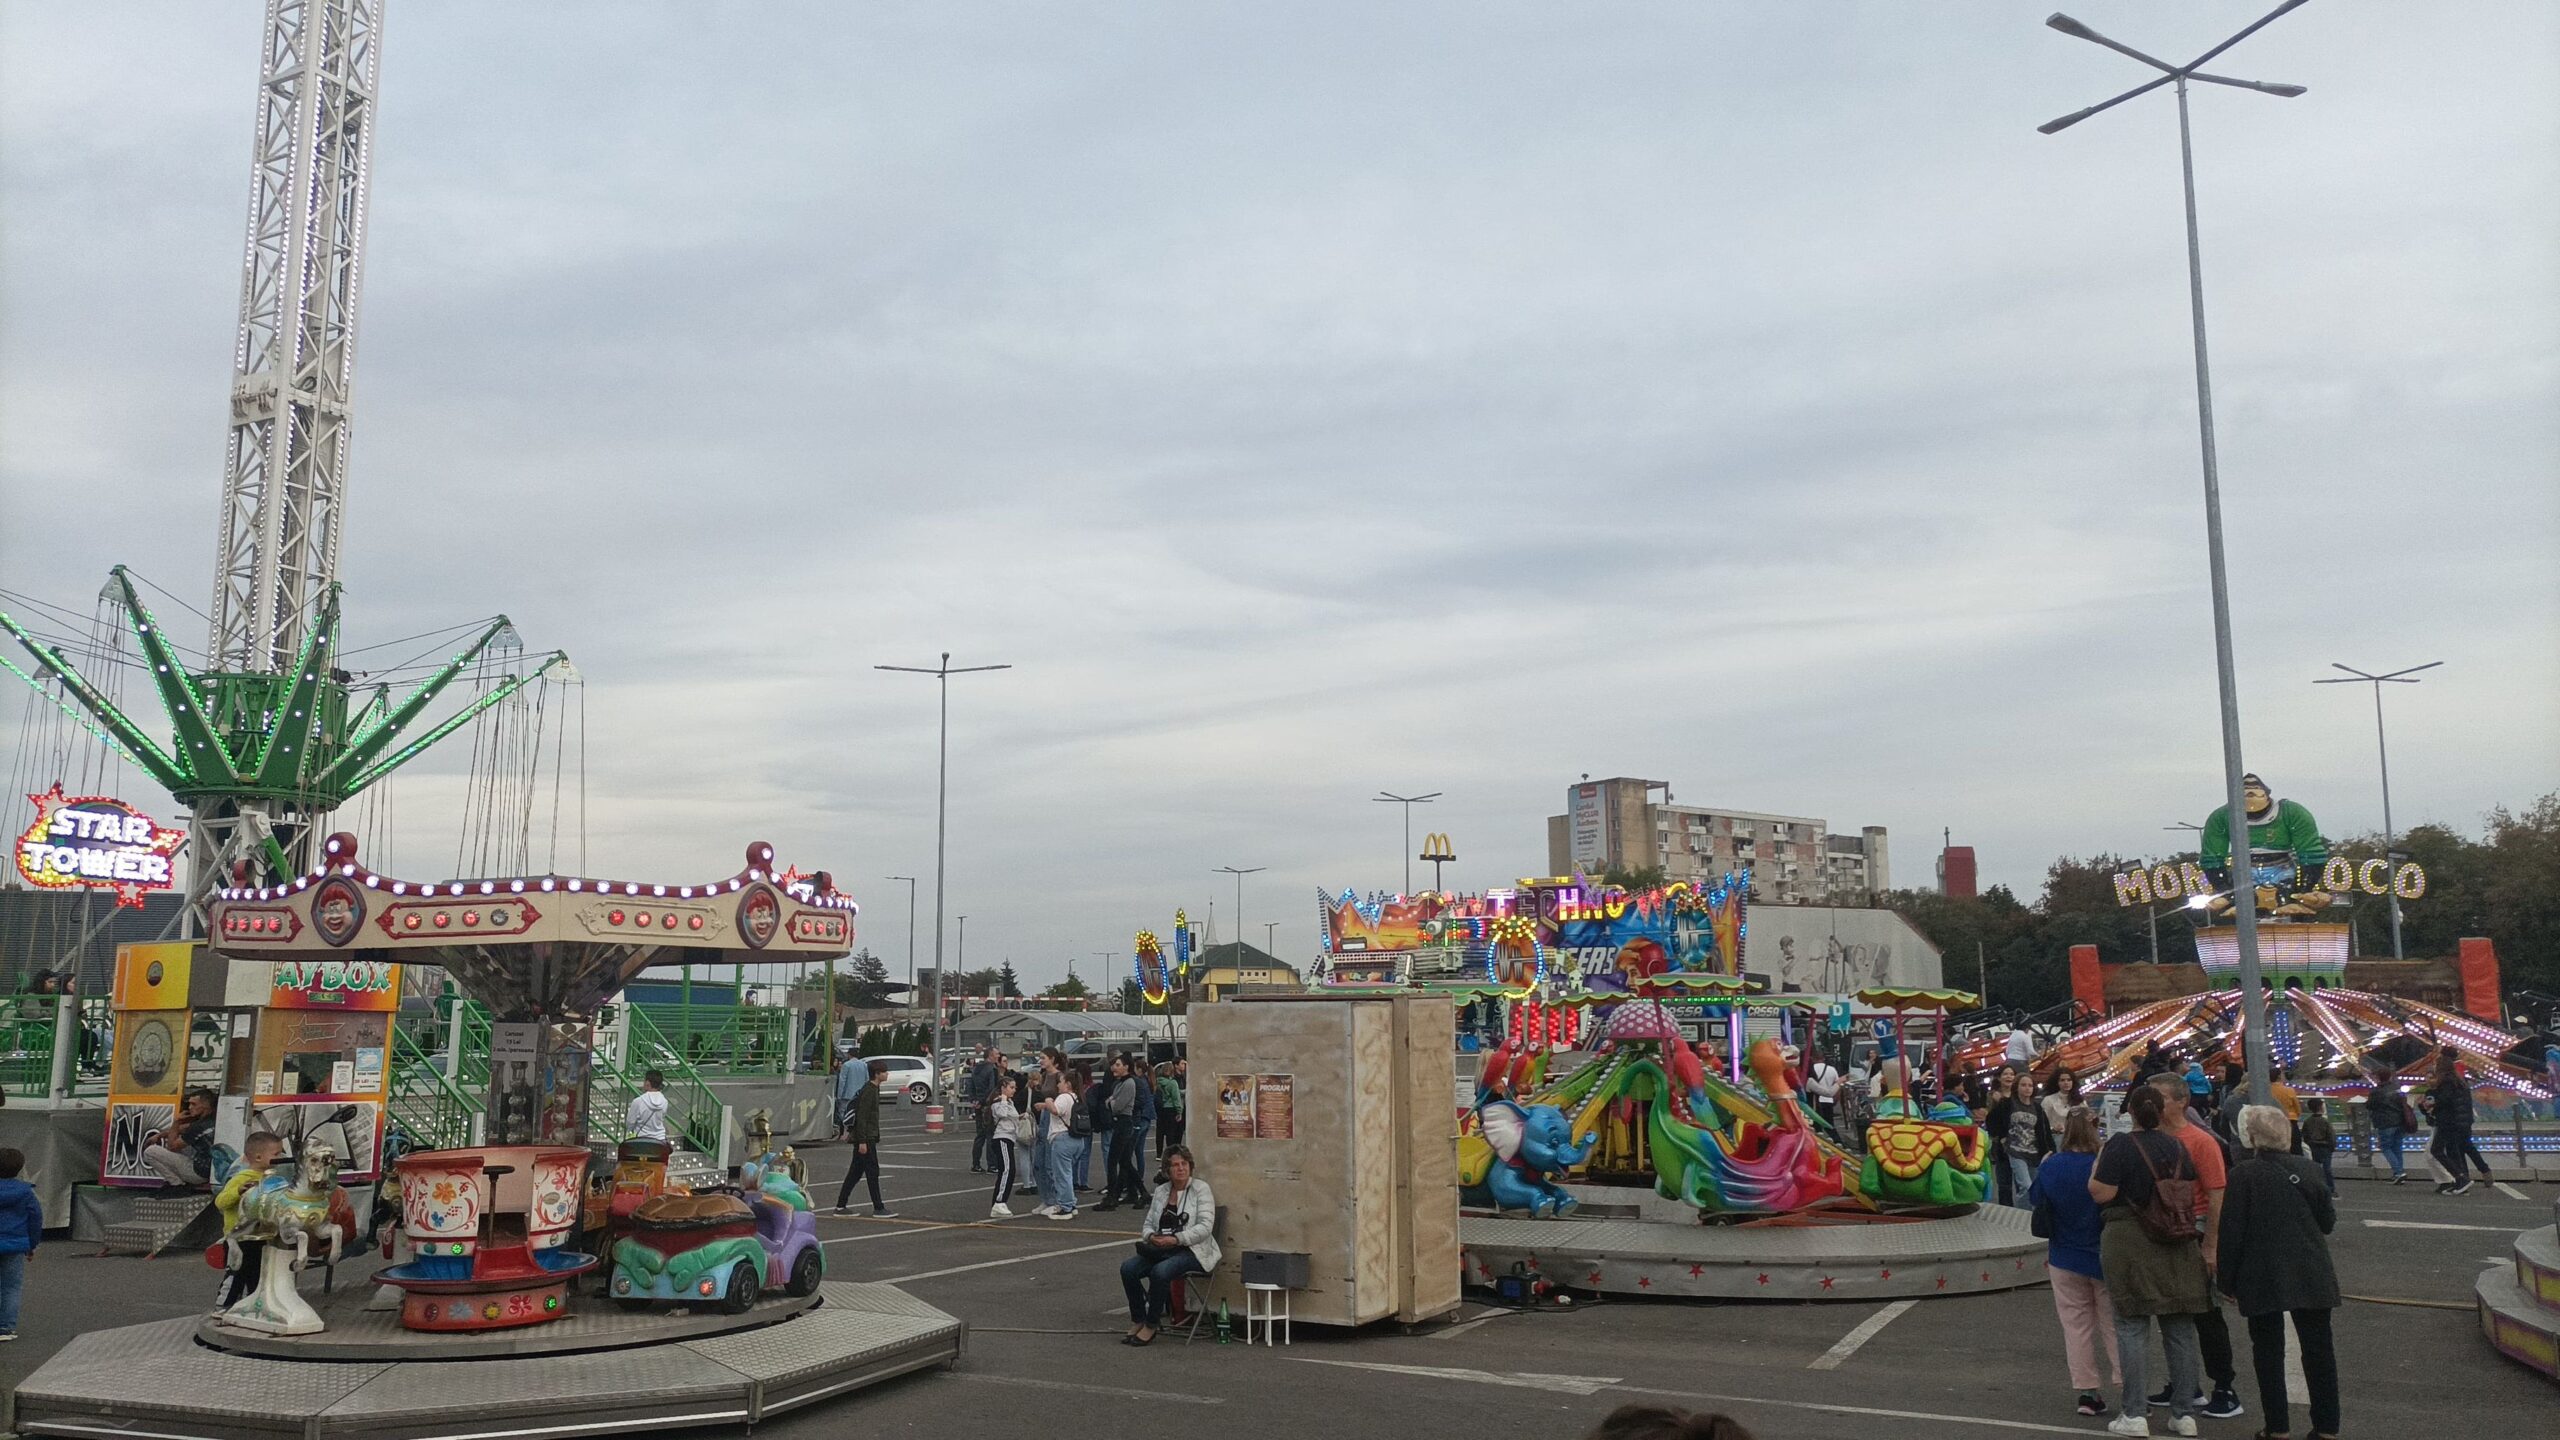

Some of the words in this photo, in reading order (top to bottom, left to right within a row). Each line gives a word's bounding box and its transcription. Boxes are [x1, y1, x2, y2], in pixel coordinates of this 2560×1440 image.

[50, 808, 153, 845] STAR
[22, 842, 170, 882] TOWER
[1747, 1006, 1780, 1017] CASSA
[1259, 1084, 1291, 1092] PROGRAM
